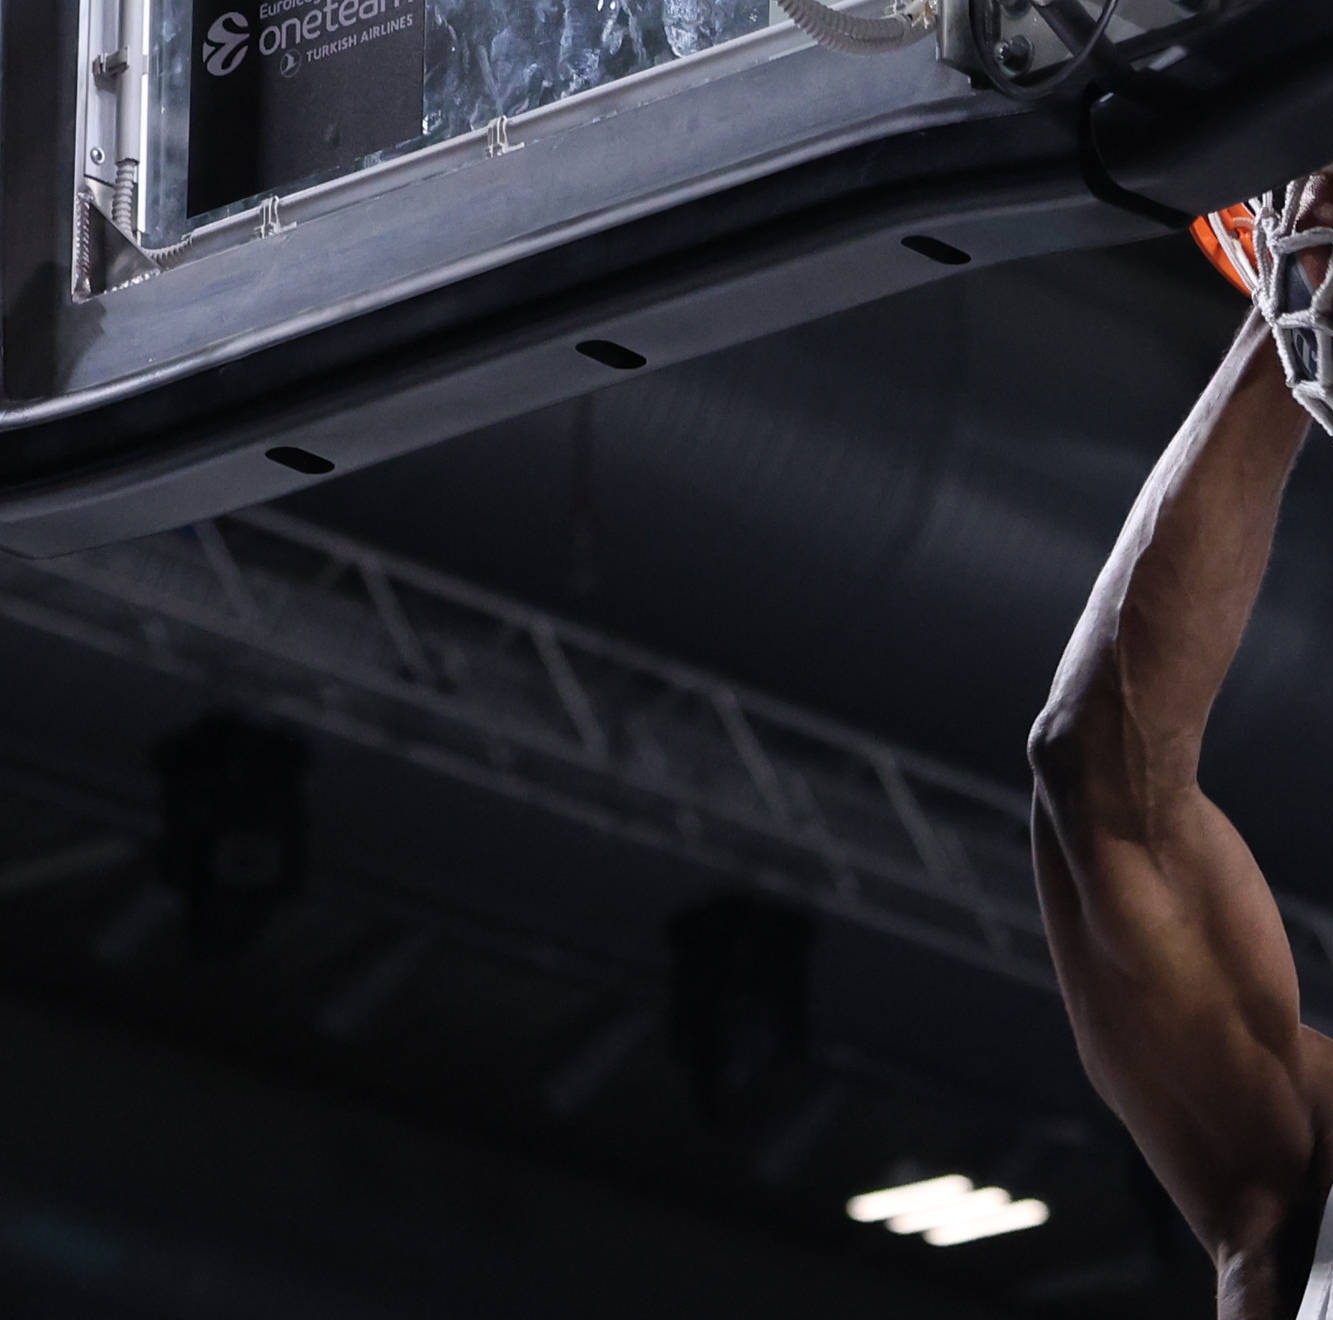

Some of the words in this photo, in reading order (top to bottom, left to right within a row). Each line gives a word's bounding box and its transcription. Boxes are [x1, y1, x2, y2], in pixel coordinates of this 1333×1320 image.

[259, 0, 413, 55] onetea
[306, 34, 357, 62] TURKISH
[360, 14, 414, 43] AIRLINES
